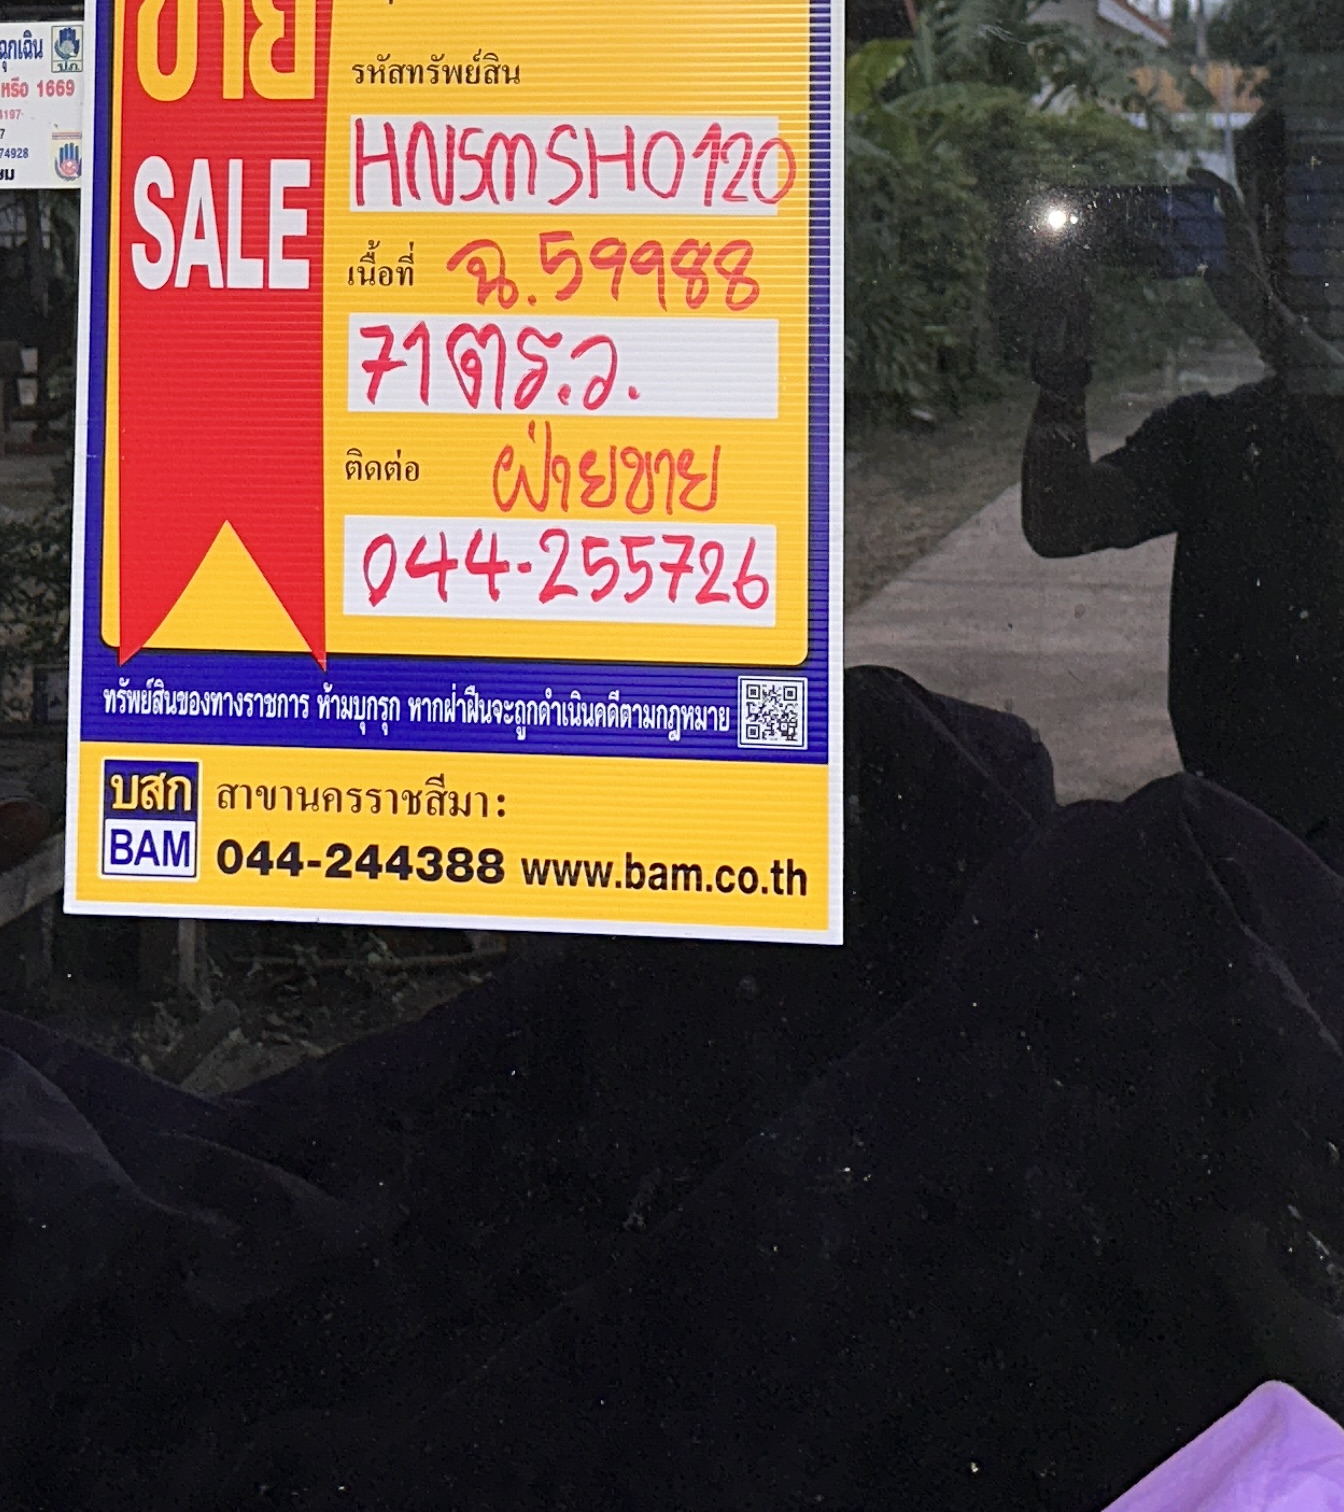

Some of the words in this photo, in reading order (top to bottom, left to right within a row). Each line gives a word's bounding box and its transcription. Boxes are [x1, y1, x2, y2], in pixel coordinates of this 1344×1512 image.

[1, 77, 29, 98] หรือ
[37, 79, 75, 98] 1669
[351, 48, 522, 86] รหัสทรัพย์สิน
[131, 155, 311, 290] SALE
[347, 239, 415, 286] เนื้อที่
[344, 447, 420, 482] ติดต่อ
[492, 419, 722, 516] ฝ่ายขาย
[363, 527, 770, 610] 044-255726
[103, 676, 310, 719] ทรัพย์สินของทางราชการ
[317, 681, 401, 736] ห้ามบุกรุก
[408, 683, 730, 742] หากฝ่าฝืนจะถูกดำเนินคดีตามกฎหมาย
[110, 770, 193, 814] บสก
[109, 827, 191, 870] BAM
[216, 839, 505, 884] 044-244388
[521, 852, 808, 896] www.bam.co.th
